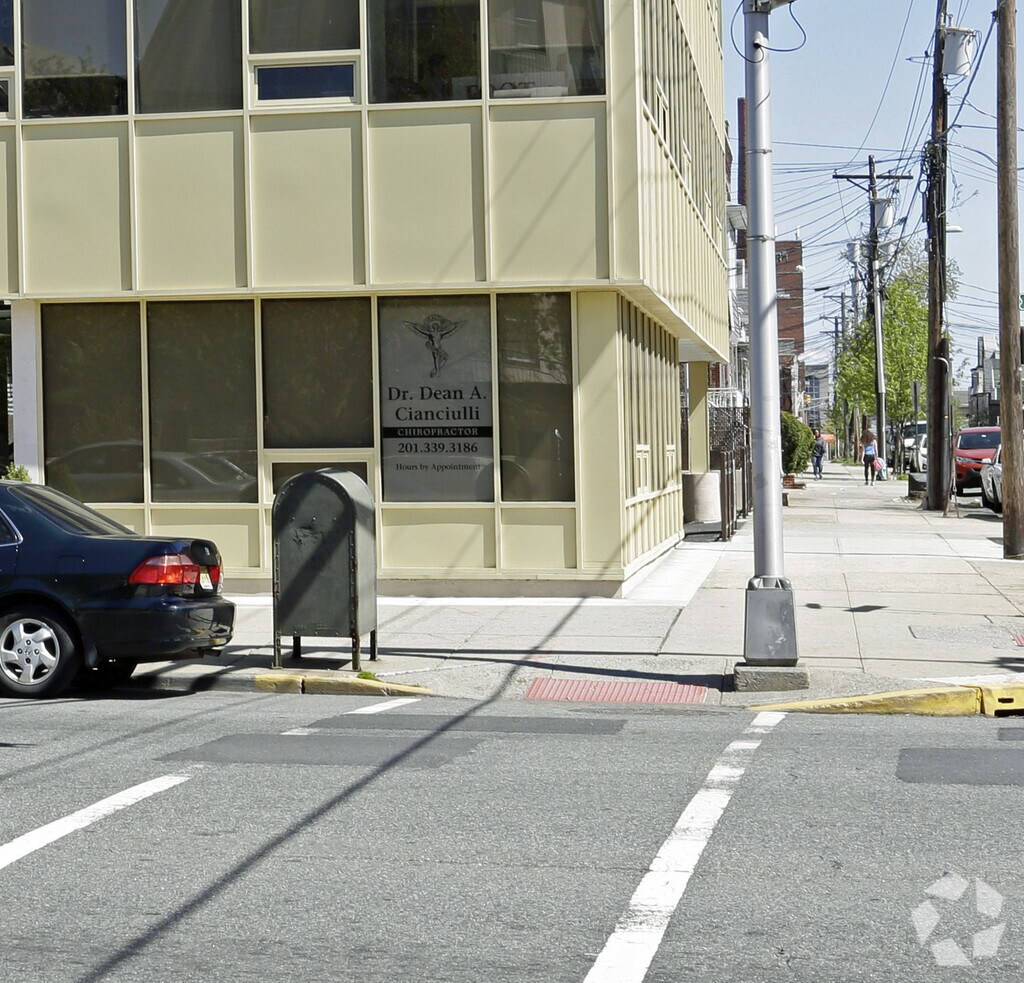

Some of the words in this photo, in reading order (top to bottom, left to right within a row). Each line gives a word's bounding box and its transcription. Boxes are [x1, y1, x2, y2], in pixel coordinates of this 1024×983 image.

[388, 386, 413, 401] Dr.
[419, 386, 463, 400] Dean
[469, 385, 487, 400] A.
[395, 405, 480, 421] Cianciulli
[397, 427, 479, 436] CHIROPRACTOR
[397, 441, 478, 454] 201.339.3186
[395, 462, 419, 471] Hours
[419, 462, 429, 472] by
[431, 462, 482, 473] Appointment
